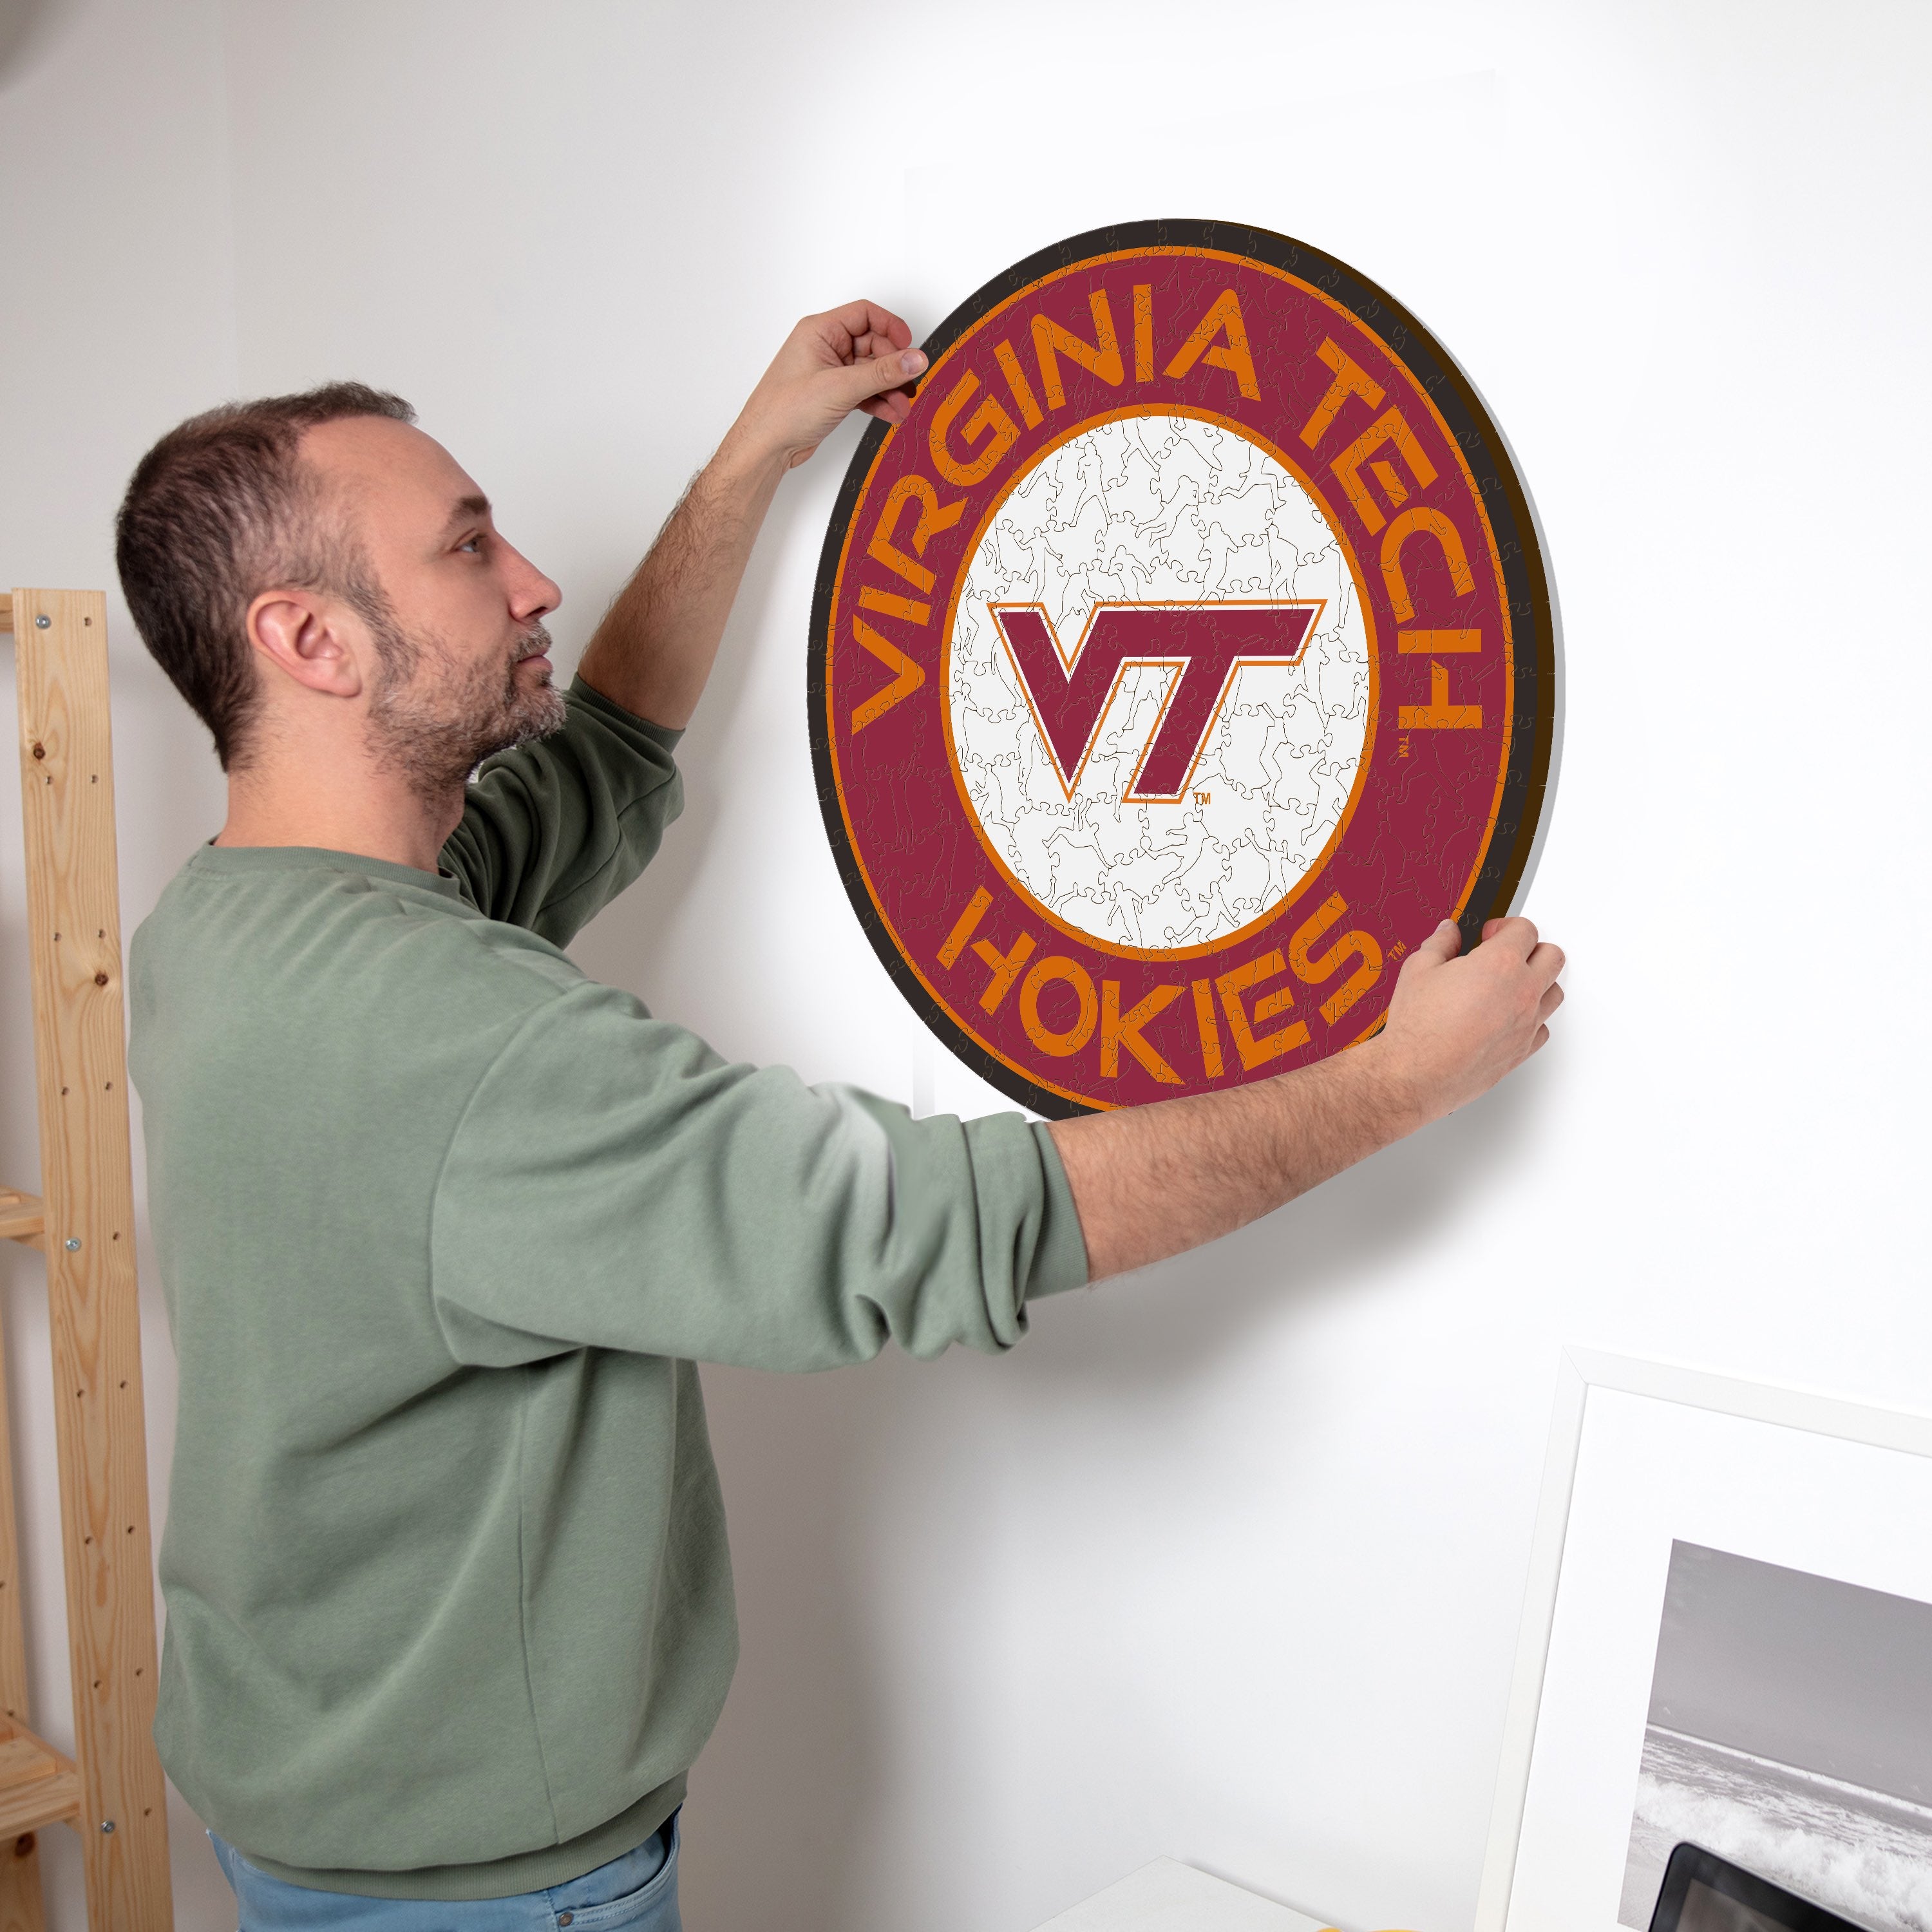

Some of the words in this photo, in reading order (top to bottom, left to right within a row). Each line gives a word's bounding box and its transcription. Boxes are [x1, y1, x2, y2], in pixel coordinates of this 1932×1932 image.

[851, 284, 1262, 734] VIRGINIA
[1299, 337, 1482, 730] TECH
[986, 598, 1329, 804] VT
[936, 887, 1383, 1085] HOKIES
